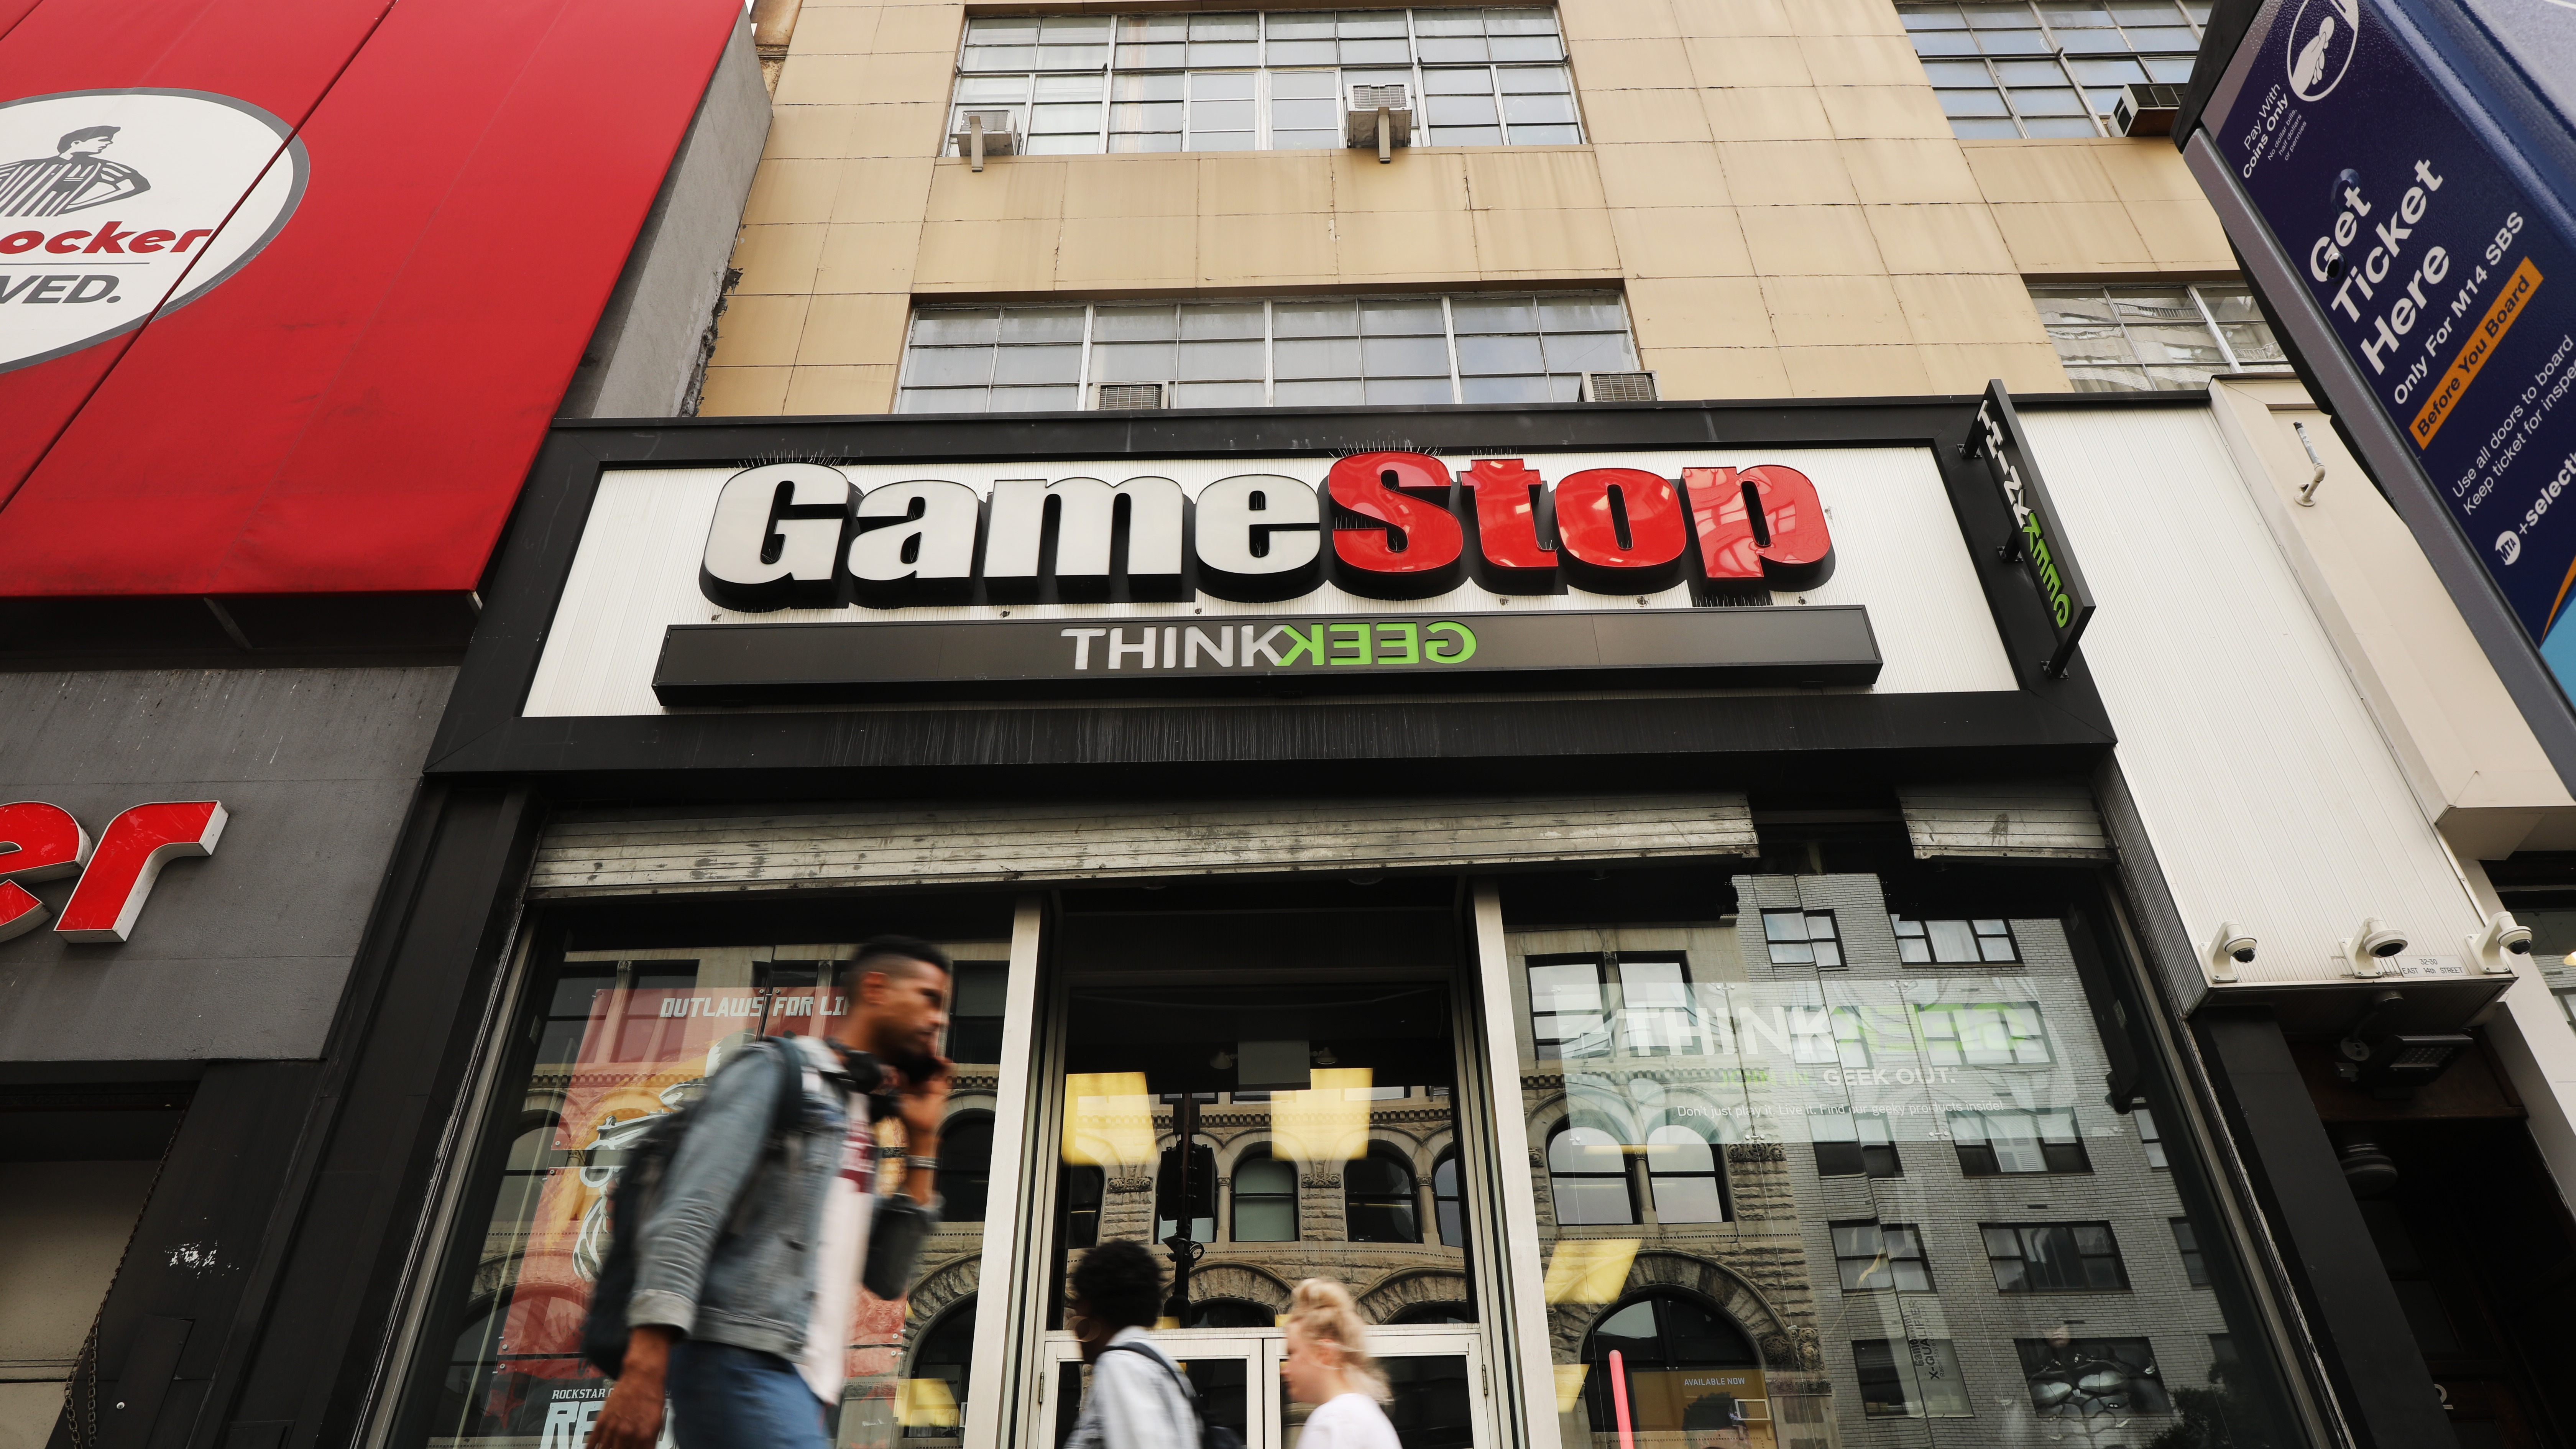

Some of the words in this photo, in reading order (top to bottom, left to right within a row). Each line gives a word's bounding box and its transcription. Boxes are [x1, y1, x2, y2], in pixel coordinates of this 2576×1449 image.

[2243, 134, 2268, 178] Coins
[2267, 93, 2288, 131] Only
[2244, 120, 2261, 150] Pay
[2259, 84, 2280, 118] With
[2267, 149, 2275, 161] No
[2275, 126, 2287, 148] dollar
[2286, 109, 2297, 126] bills,
[2279, 140, 2287, 156] half
[2287, 115, 2302, 140] dollars
[2290, 121, 2307, 152] pennies
[2311, 187, 2371, 282] Get
[2331, 160, 2443, 323] Ticket
[2361, 246, 2449, 375] Here
[2395, 356, 2428, 404] Only
[2425, 317, 2452, 356] For
[2451, 265, 2487, 317] M14
[2486, 212, 2523, 265] SBS
[2418, 378, 2460, 437] Before
[2458, 339, 2487, 374] You
[2485, 275, 2530, 338] Board
[2453, 468, 2476, 497] Use
[2477, 446, 2491, 468] all
[2491, 405, 2523, 449] doors
[2522, 387, 2537, 404] to
[2535, 335, 2574, 386] board
[2464, 476, 2494, 515] Keep
[2493, 432, 2526, 476] ticket
[2524, 409, 2542, 435] for
[703, 449, 1833, 592] GameStop
[660, 997, 764, 1017] OUTLAWS
[772, 997, 814, 1017] FOR
[1677, 1106, 1707, 1116] Don't
[1711, 1106, 1732, 1119] just
[1735, 1105, 1761, 1118] play
[1764, 1105, 1775, 1115] it.
[1778, 1104, 1802, 1115] Live
[1805, 1104, 1816, 1114] it.
[1820, 1104, 1845, 1115] Find
[1849, 1106, 1867, 1114] our
[1872, 1102, 1904, 1116] geeky
[1909, 1102, 1963, 1116] products
[1966, 1100, 2003, 1111] inside!
[1718, 1070, 1777, 1087] JOIN
[1823, 1068, 1891, 1086] GEEK
[551, 1388, 606, 1400] ROCKSTAR
[1684, 1378, 1725, 1386] AVAILABLE
[1936, 1360, 1945, 1377] Racer
